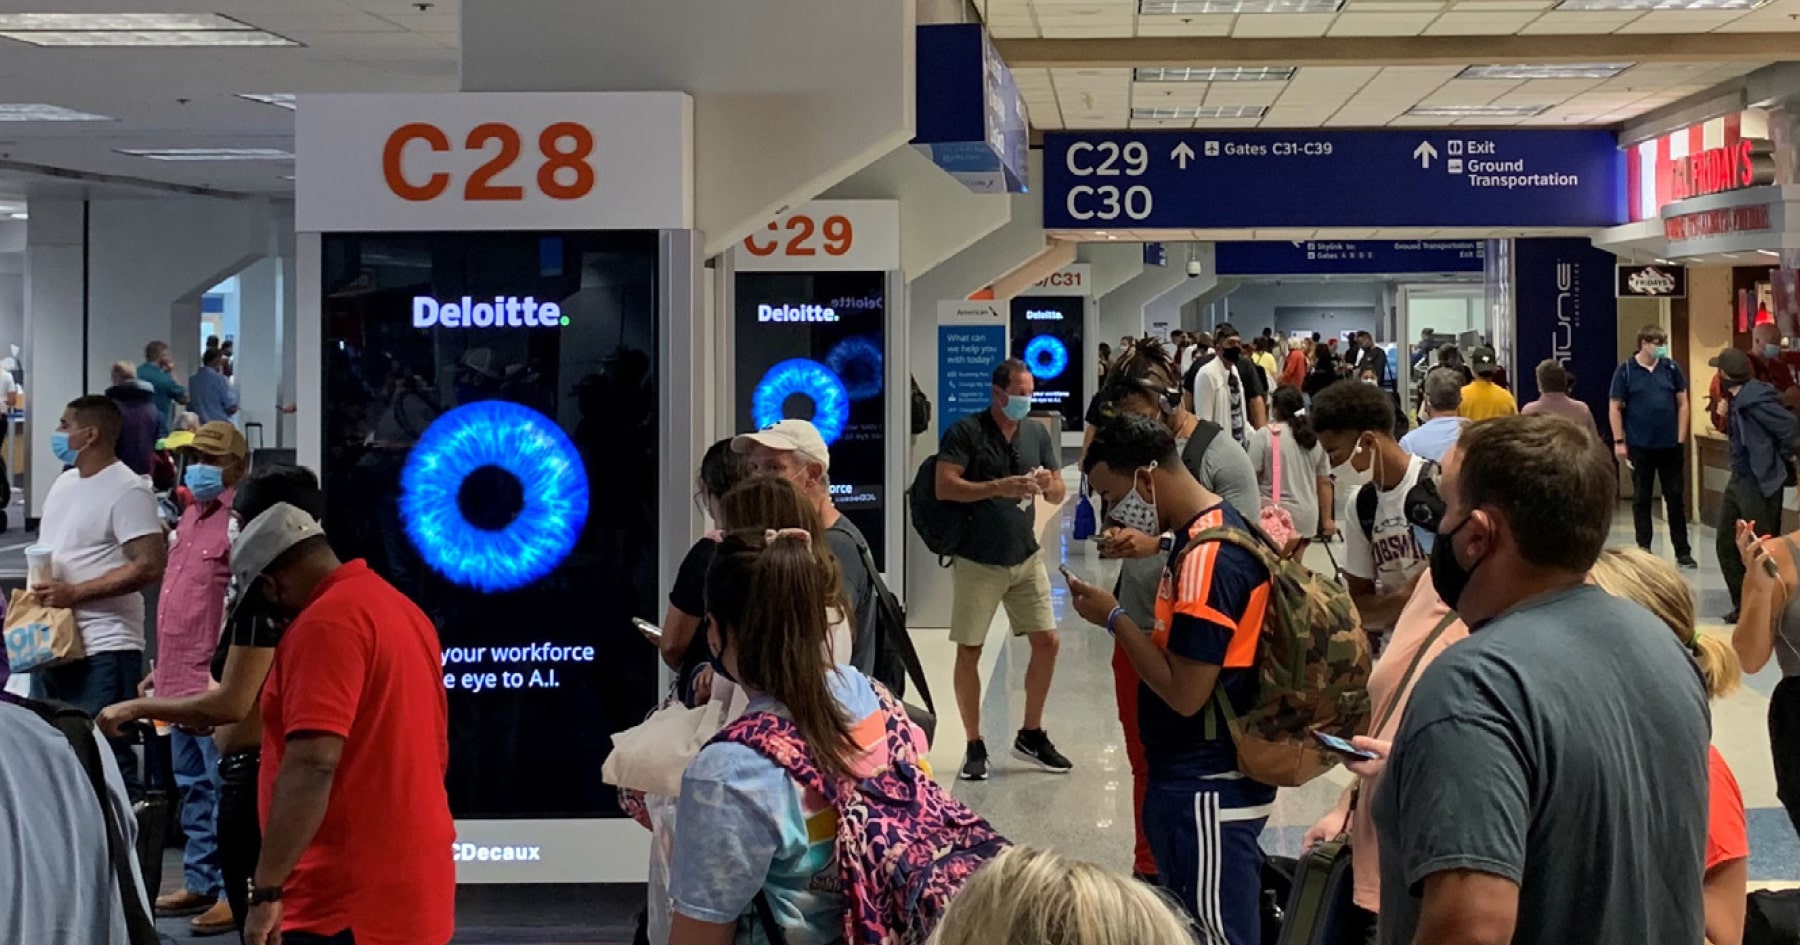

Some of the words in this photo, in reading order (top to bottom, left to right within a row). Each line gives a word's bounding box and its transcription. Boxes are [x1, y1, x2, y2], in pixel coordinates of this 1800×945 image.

[1225, 142, 1267, 155] Gates
[1273, 142, 1333, 155] C31-C39
[1467, 140, 1495, 154] Exit
[382, 122, 596, 201] C28
[1066, 141, 1148, 176] C29
[1467, 159, 1523, 172] Ground
[1468, 172, 1578, 189] Transportation
[1066, 185, 1153, 220] C30
[743, 214, 853, 256] C29
[412, 296, 570, 328] Deloitte.
[757, 304, 840, 322] Deloitte.
[947, 334, 970, 342] What
[961, 344, 980, 354] help
[981, 346, 997, 354] you
[947, 355, 965, 364] with
[966, 355, 995, 366] today?
[441, 647, 486, 666] your
[491, 642, 595, 662] workforce
[461, 672, 497, 693] eye
[502, 671, 524, 688] to
[528, 668, 560, 688] A.I.
